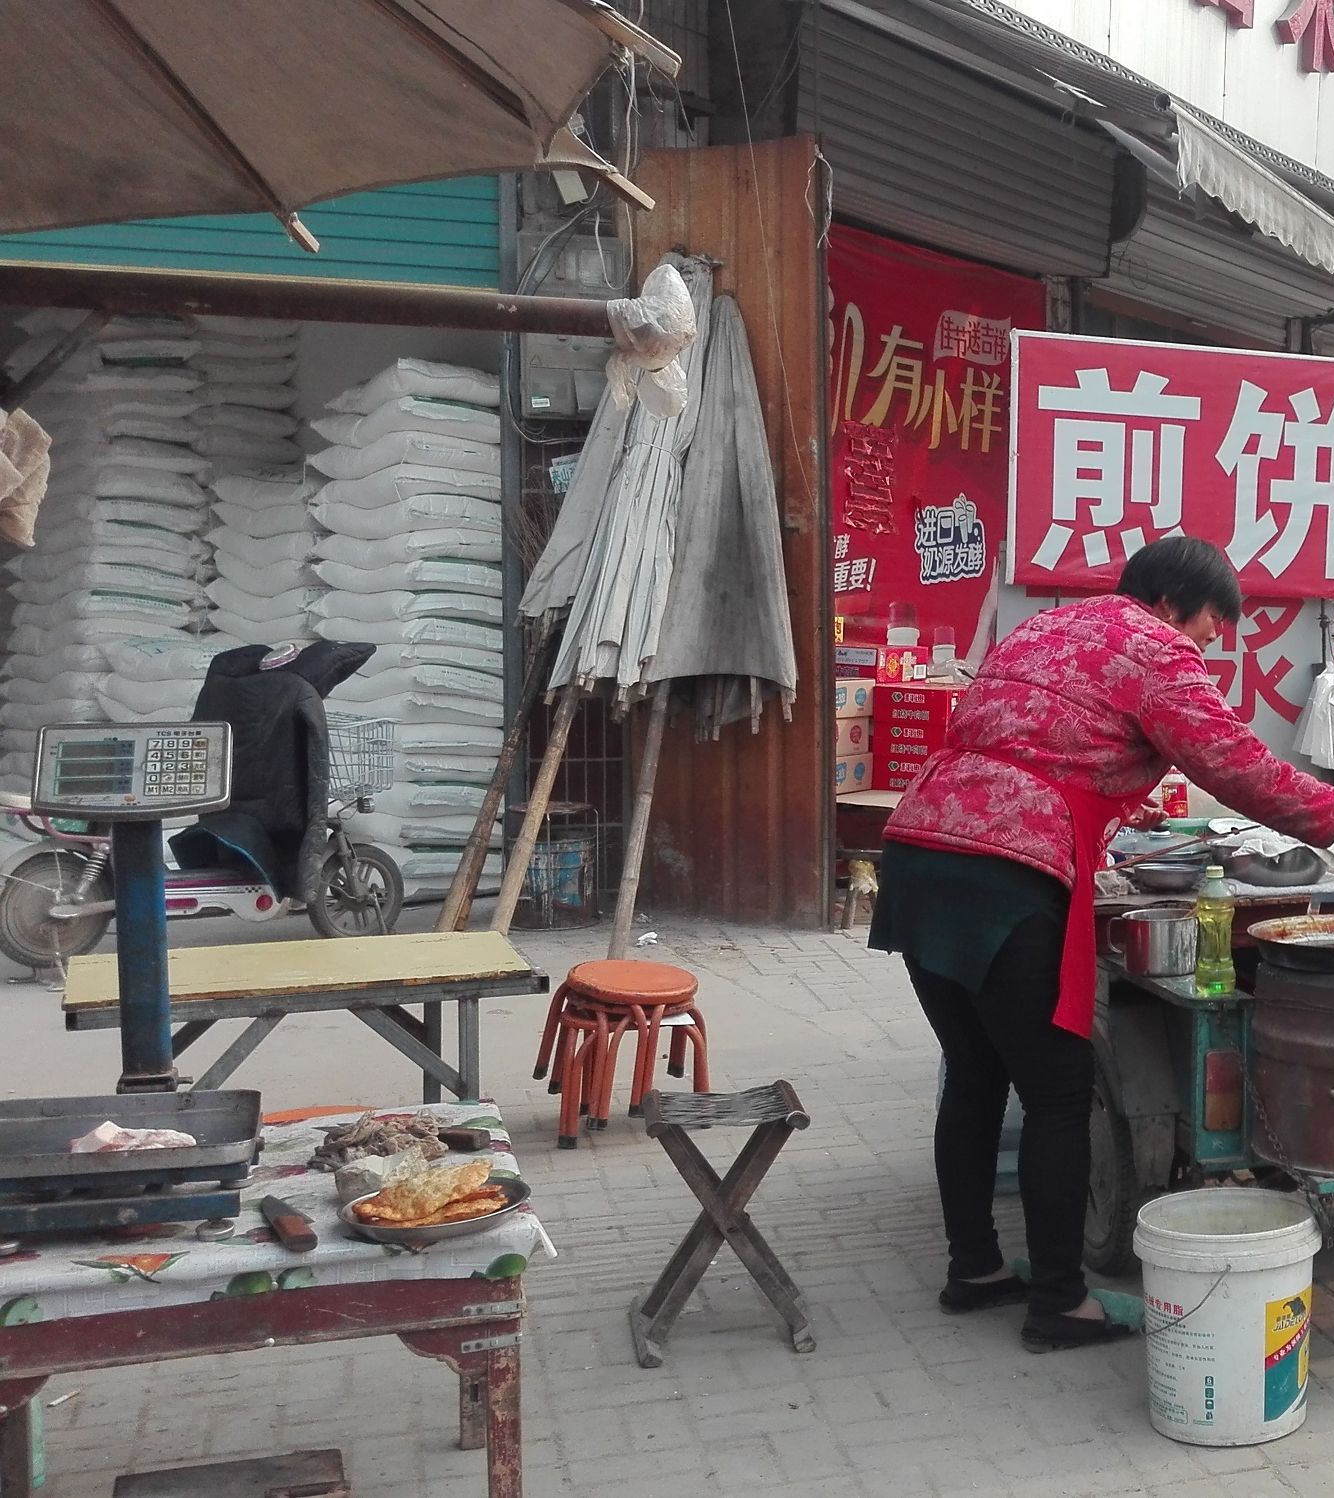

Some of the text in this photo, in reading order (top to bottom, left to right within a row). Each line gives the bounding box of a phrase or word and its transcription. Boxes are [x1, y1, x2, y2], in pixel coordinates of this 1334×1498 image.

[922, 542, 984, 578] 奶源发酵
[182, 740, 190, 748] 9
[151, 752, 160, 760] 4
[166, 751, 175, 759] 5
[181, 751, 189, 759] 6
[180, 762, 189, 770] 3
